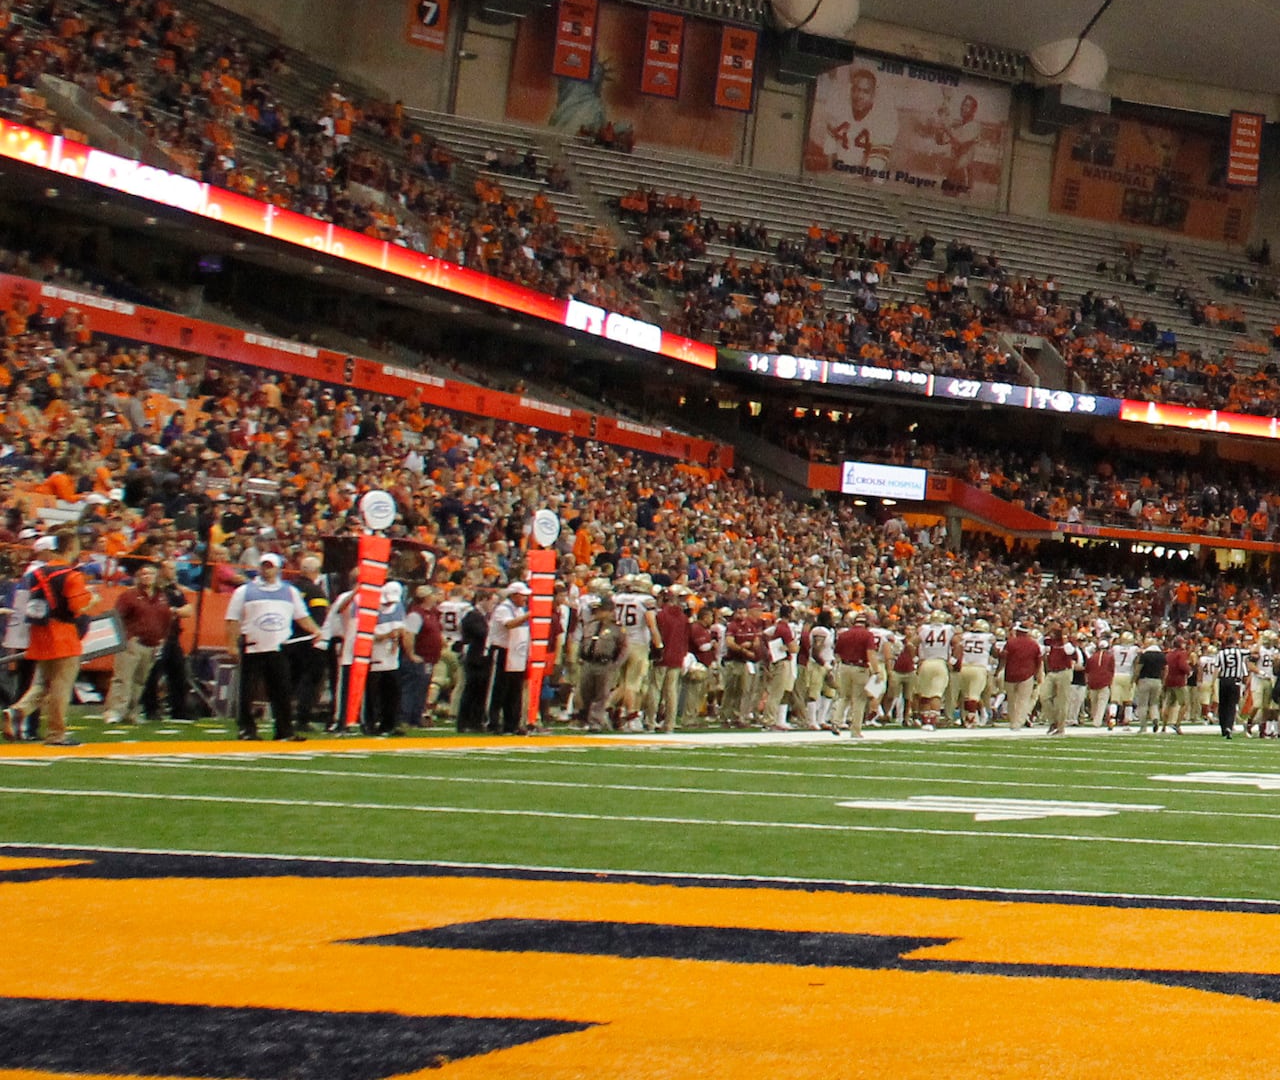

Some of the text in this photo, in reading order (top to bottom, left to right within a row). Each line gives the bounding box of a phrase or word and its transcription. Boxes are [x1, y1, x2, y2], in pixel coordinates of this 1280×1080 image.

[422, 0, 438, 25] 7
[877, 61, 961, 87] JIM BROWN
[832, 159, 891, 180] Greatest
[895, 170, 937, 188] Player
[749, 354, 769, 372] 14
[948, 379, 982, 398] 4:27
[856, 477, 922, 489] CROUSE HOSPITAL
[616, 603, 637, 627] 76
[925, 629, 947, 647] 44
[963, 639, 984, 654] 55
[1119, 651, 1128, 666] 7
[1226, 653, 1236, 668] S
